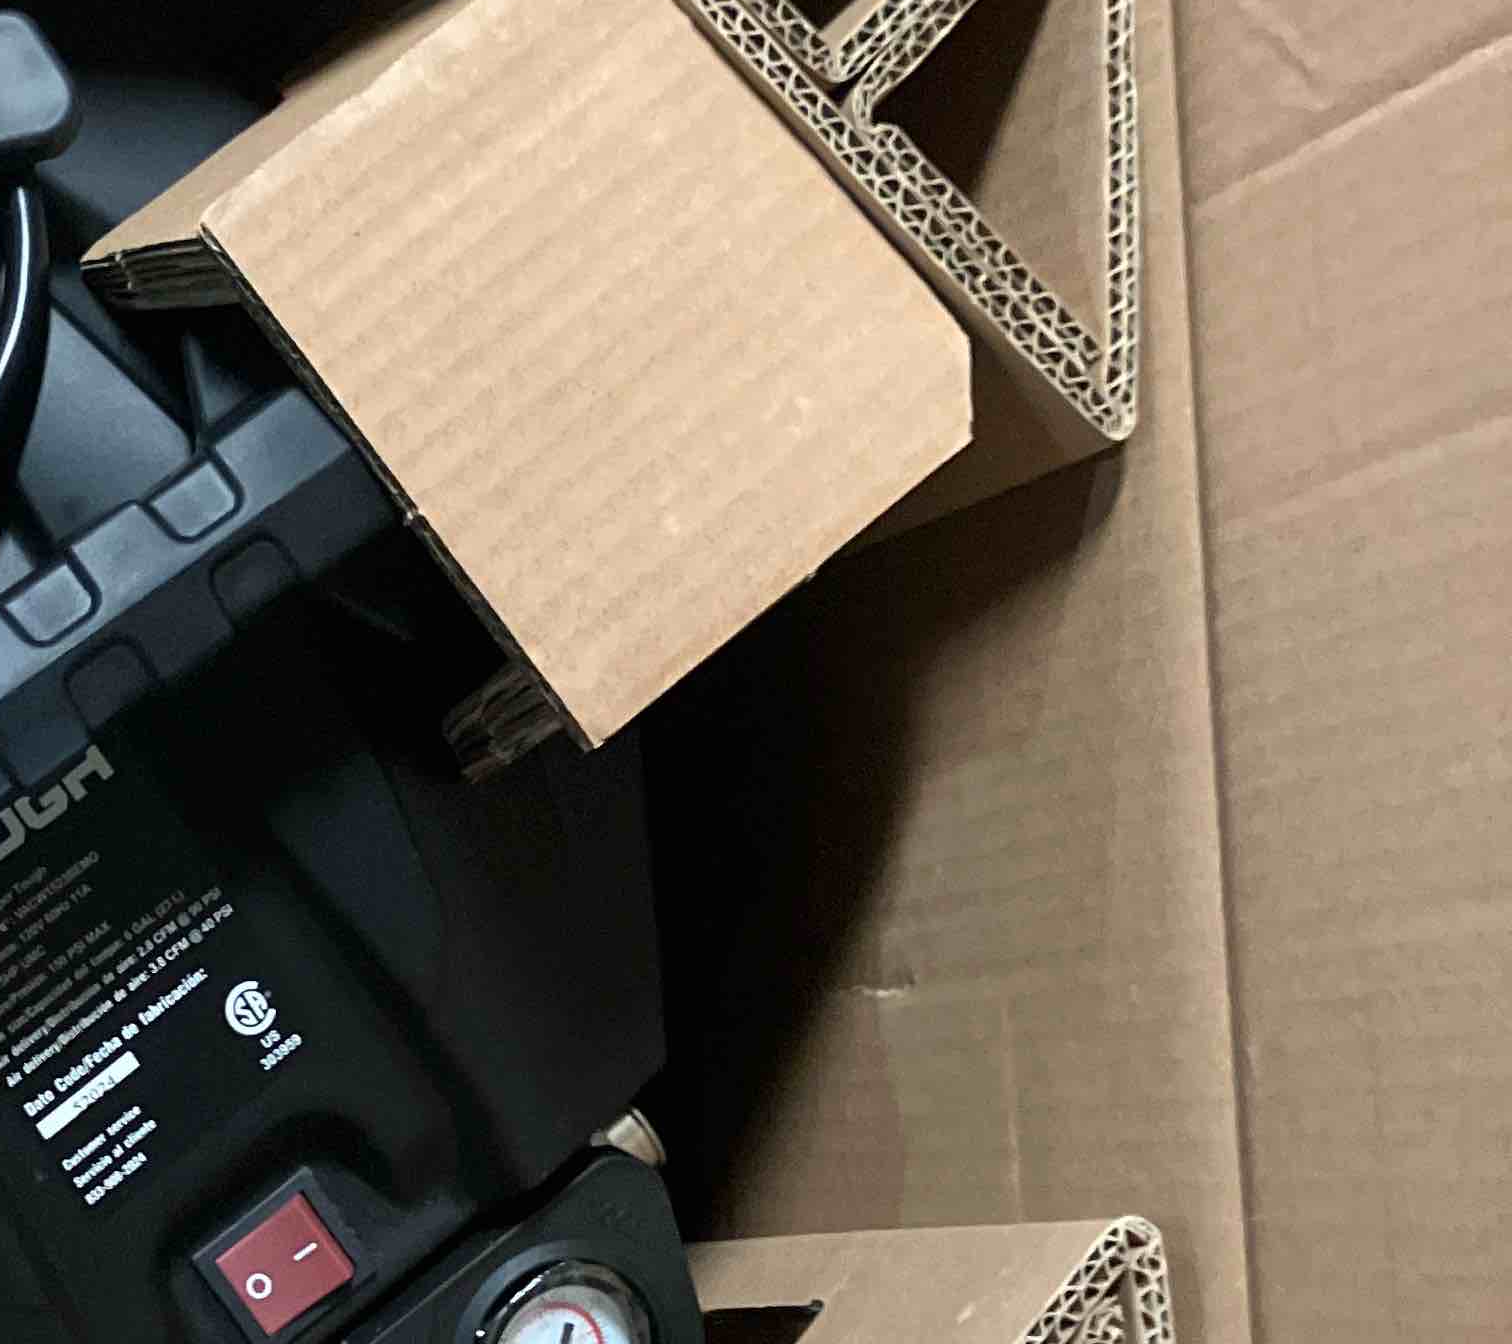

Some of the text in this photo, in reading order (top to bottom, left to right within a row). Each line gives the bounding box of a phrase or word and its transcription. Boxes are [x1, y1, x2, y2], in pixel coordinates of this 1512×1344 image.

[148, 956, 167, 974] 3.8
[164, 937, 190, 961] CFM
[201, 917, 216, 932] 40
[212, 903, 234, 923] PSI
[152, 920, 178, 944] CFM
[260, 1029, 281, 1049] US
[23, 1090, 55, 1117] Date
[121, 1023, 140, 1040] de
